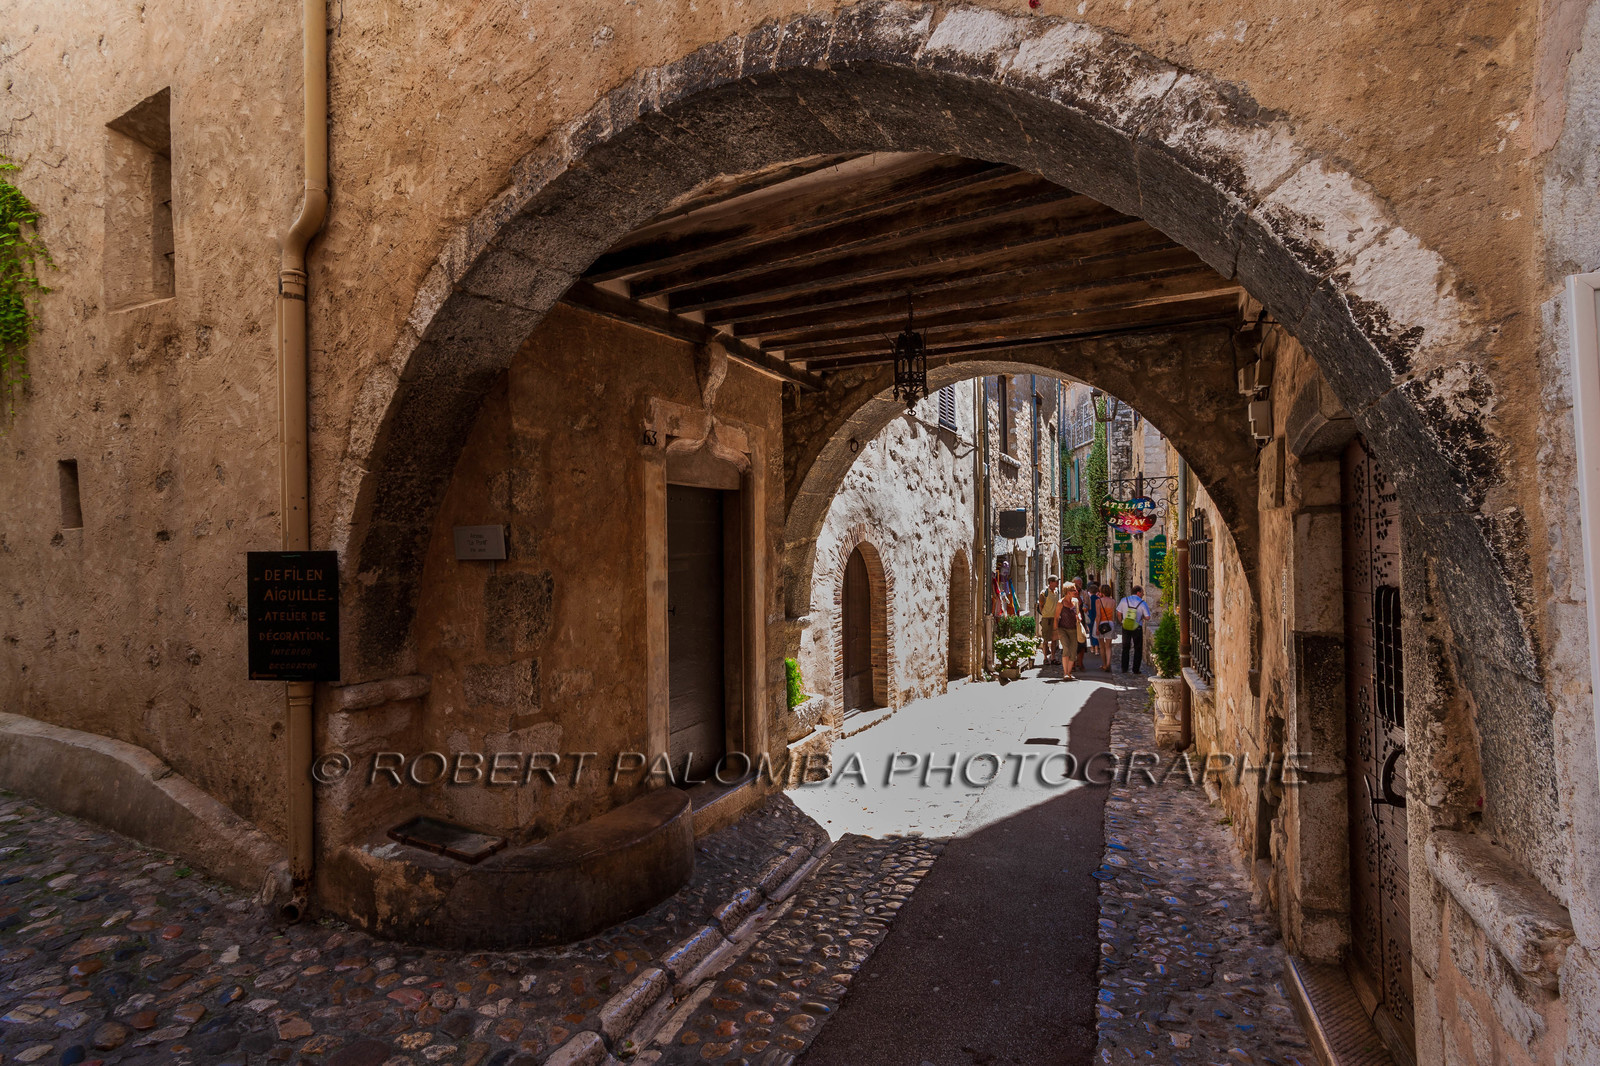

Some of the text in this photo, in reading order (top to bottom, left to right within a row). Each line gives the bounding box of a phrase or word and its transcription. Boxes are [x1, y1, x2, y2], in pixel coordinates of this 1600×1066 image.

[1102, 501, 1151, 510] ATELIER
[265, 569, 281, 581] DE
[306, 569, 323, 581] EN
[264, 608, 327, 622] ATELIER DE
